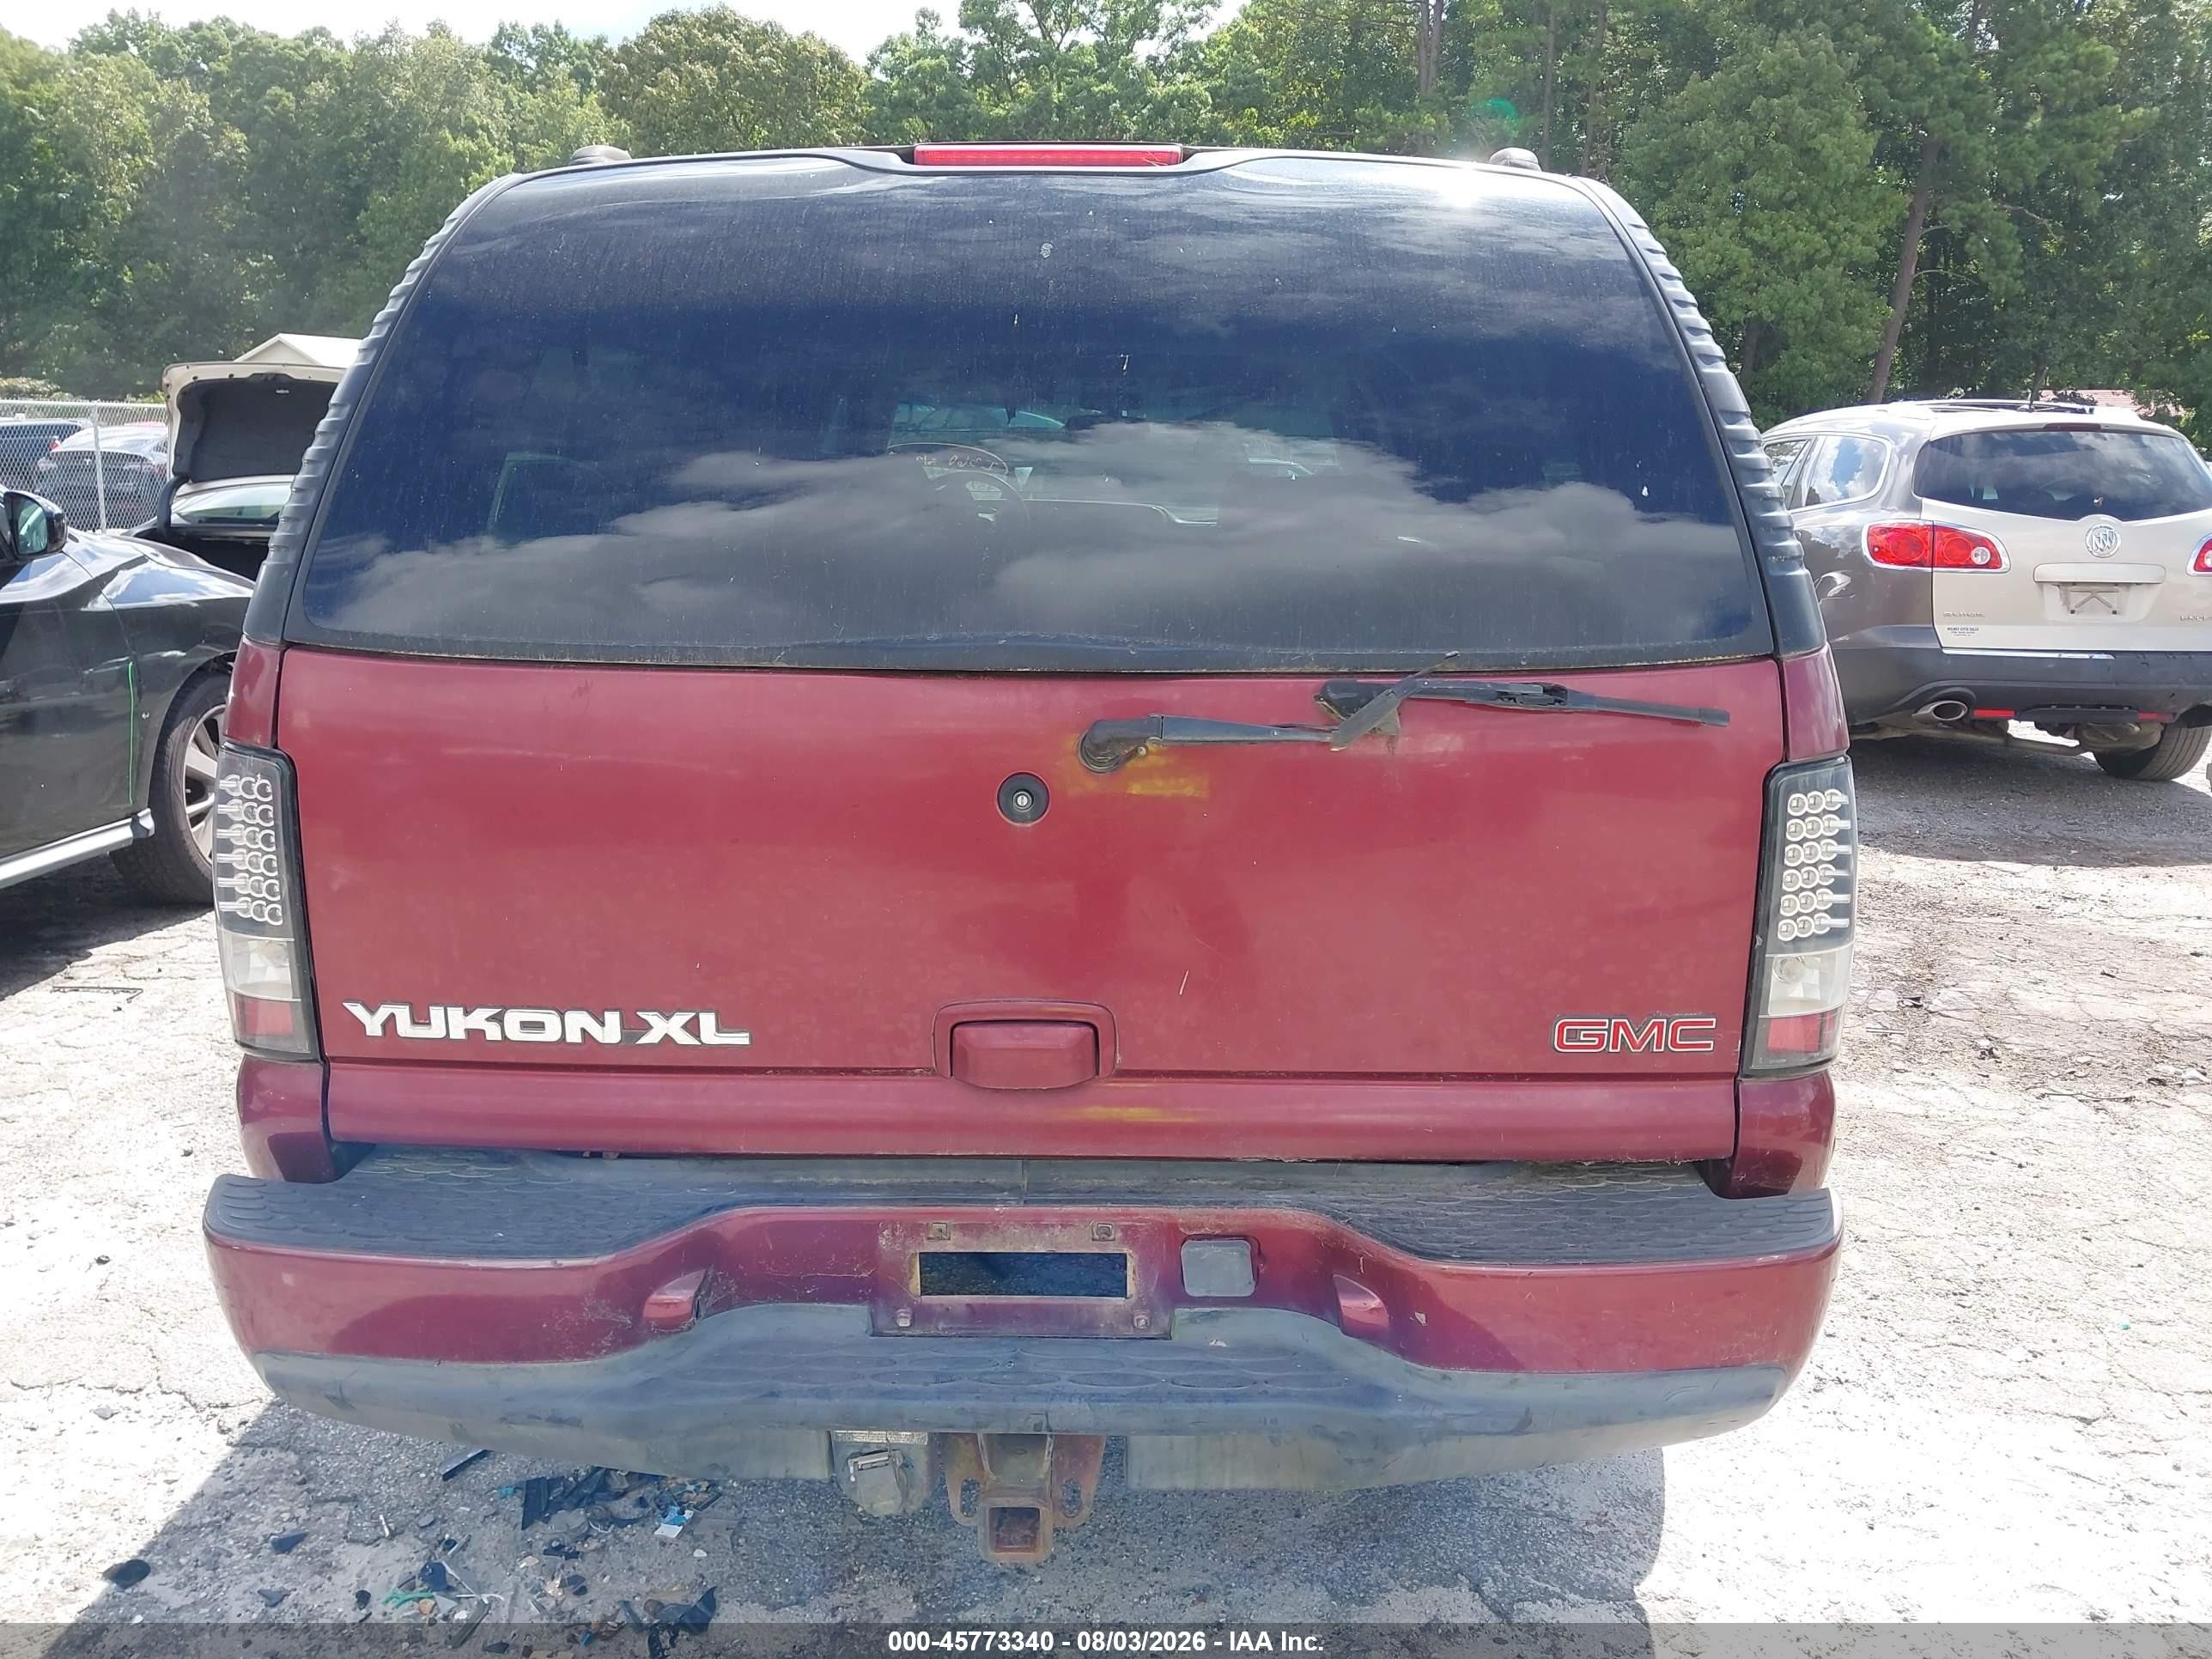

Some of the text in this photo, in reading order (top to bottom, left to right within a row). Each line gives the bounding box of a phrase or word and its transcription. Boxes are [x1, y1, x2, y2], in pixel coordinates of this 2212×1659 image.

[342, 1001, 752, 1046] YUKON XL
[1553, 1018, 1717, 1053] GMC
